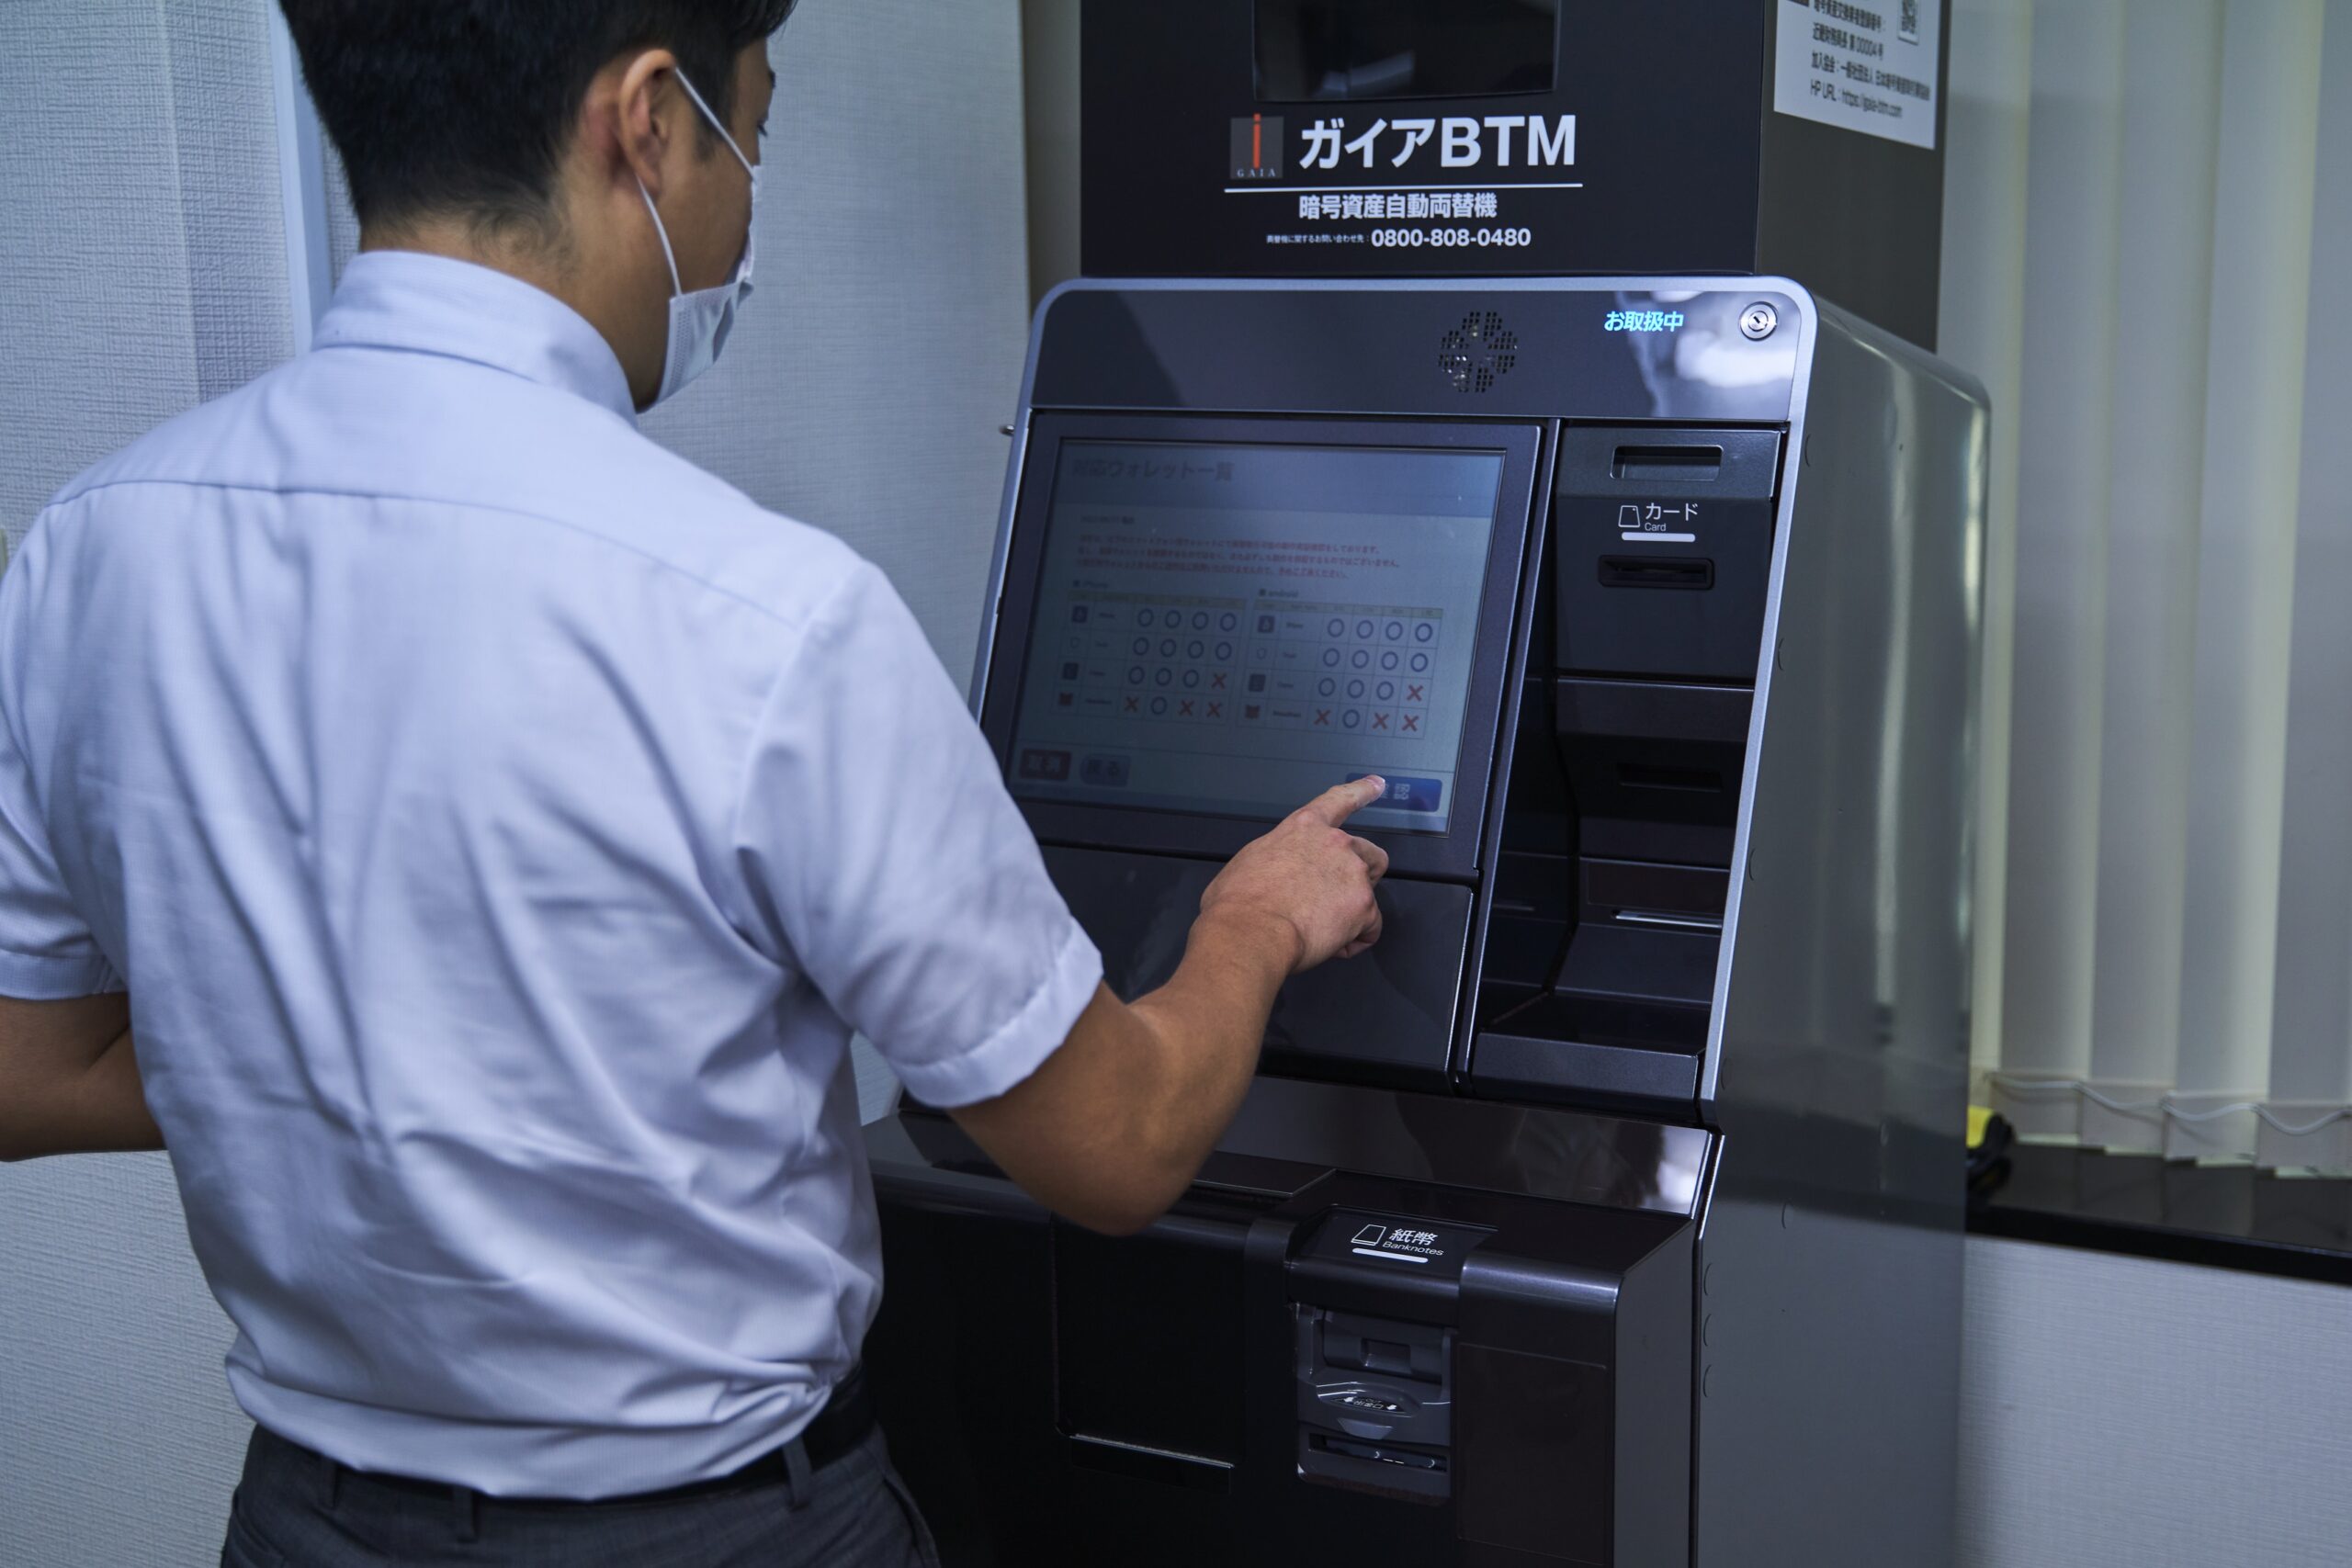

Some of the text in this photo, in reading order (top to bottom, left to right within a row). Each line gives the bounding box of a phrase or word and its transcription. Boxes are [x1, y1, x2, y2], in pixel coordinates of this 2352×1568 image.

[1298, 114, 1577, 170] ガイアBTM
[1237, 168, 1276, 178] GAIA
[1298, 193, 1498, 220] 暗号資産自動両替機
[1371, 227, 1532, 248] 0800-808-0480
[1603, 310, 1684, 333] お取扱中
[1645, 502, 1698, 522] カード
[1644, 521, 1667, 532] Card
[1388, 1227, 1438, 1247] 紙幣
[1382, 1240, 1444, 1257] Banknotes
